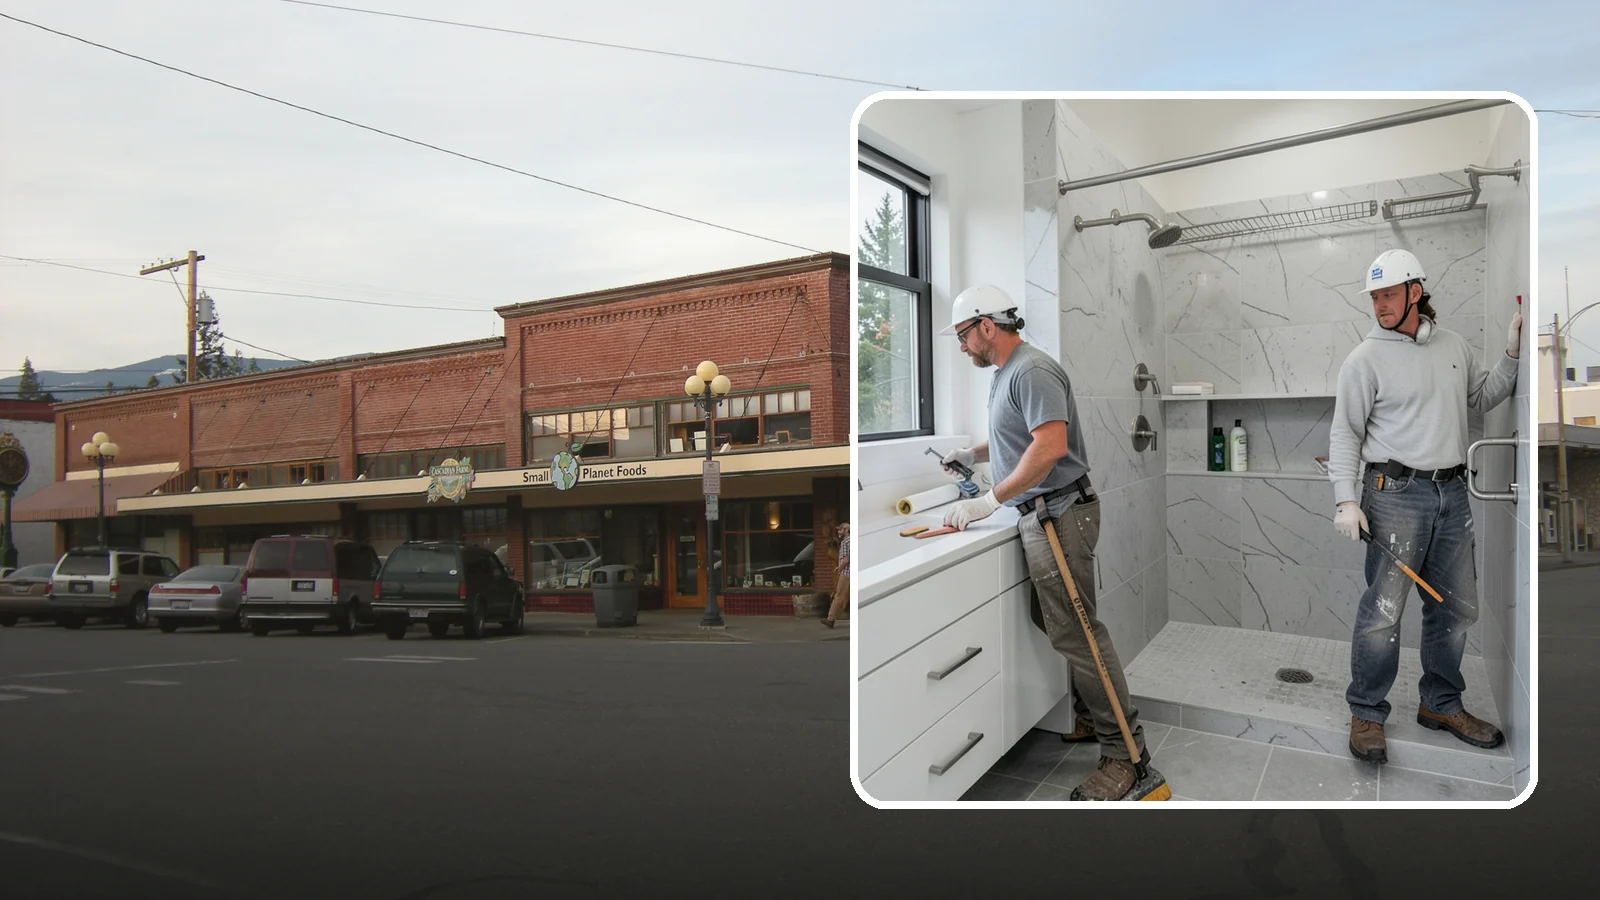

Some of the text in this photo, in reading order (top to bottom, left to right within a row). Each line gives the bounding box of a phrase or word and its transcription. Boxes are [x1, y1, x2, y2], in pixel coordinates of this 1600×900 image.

[523, 464, 647, 483] Small Planet Foods
